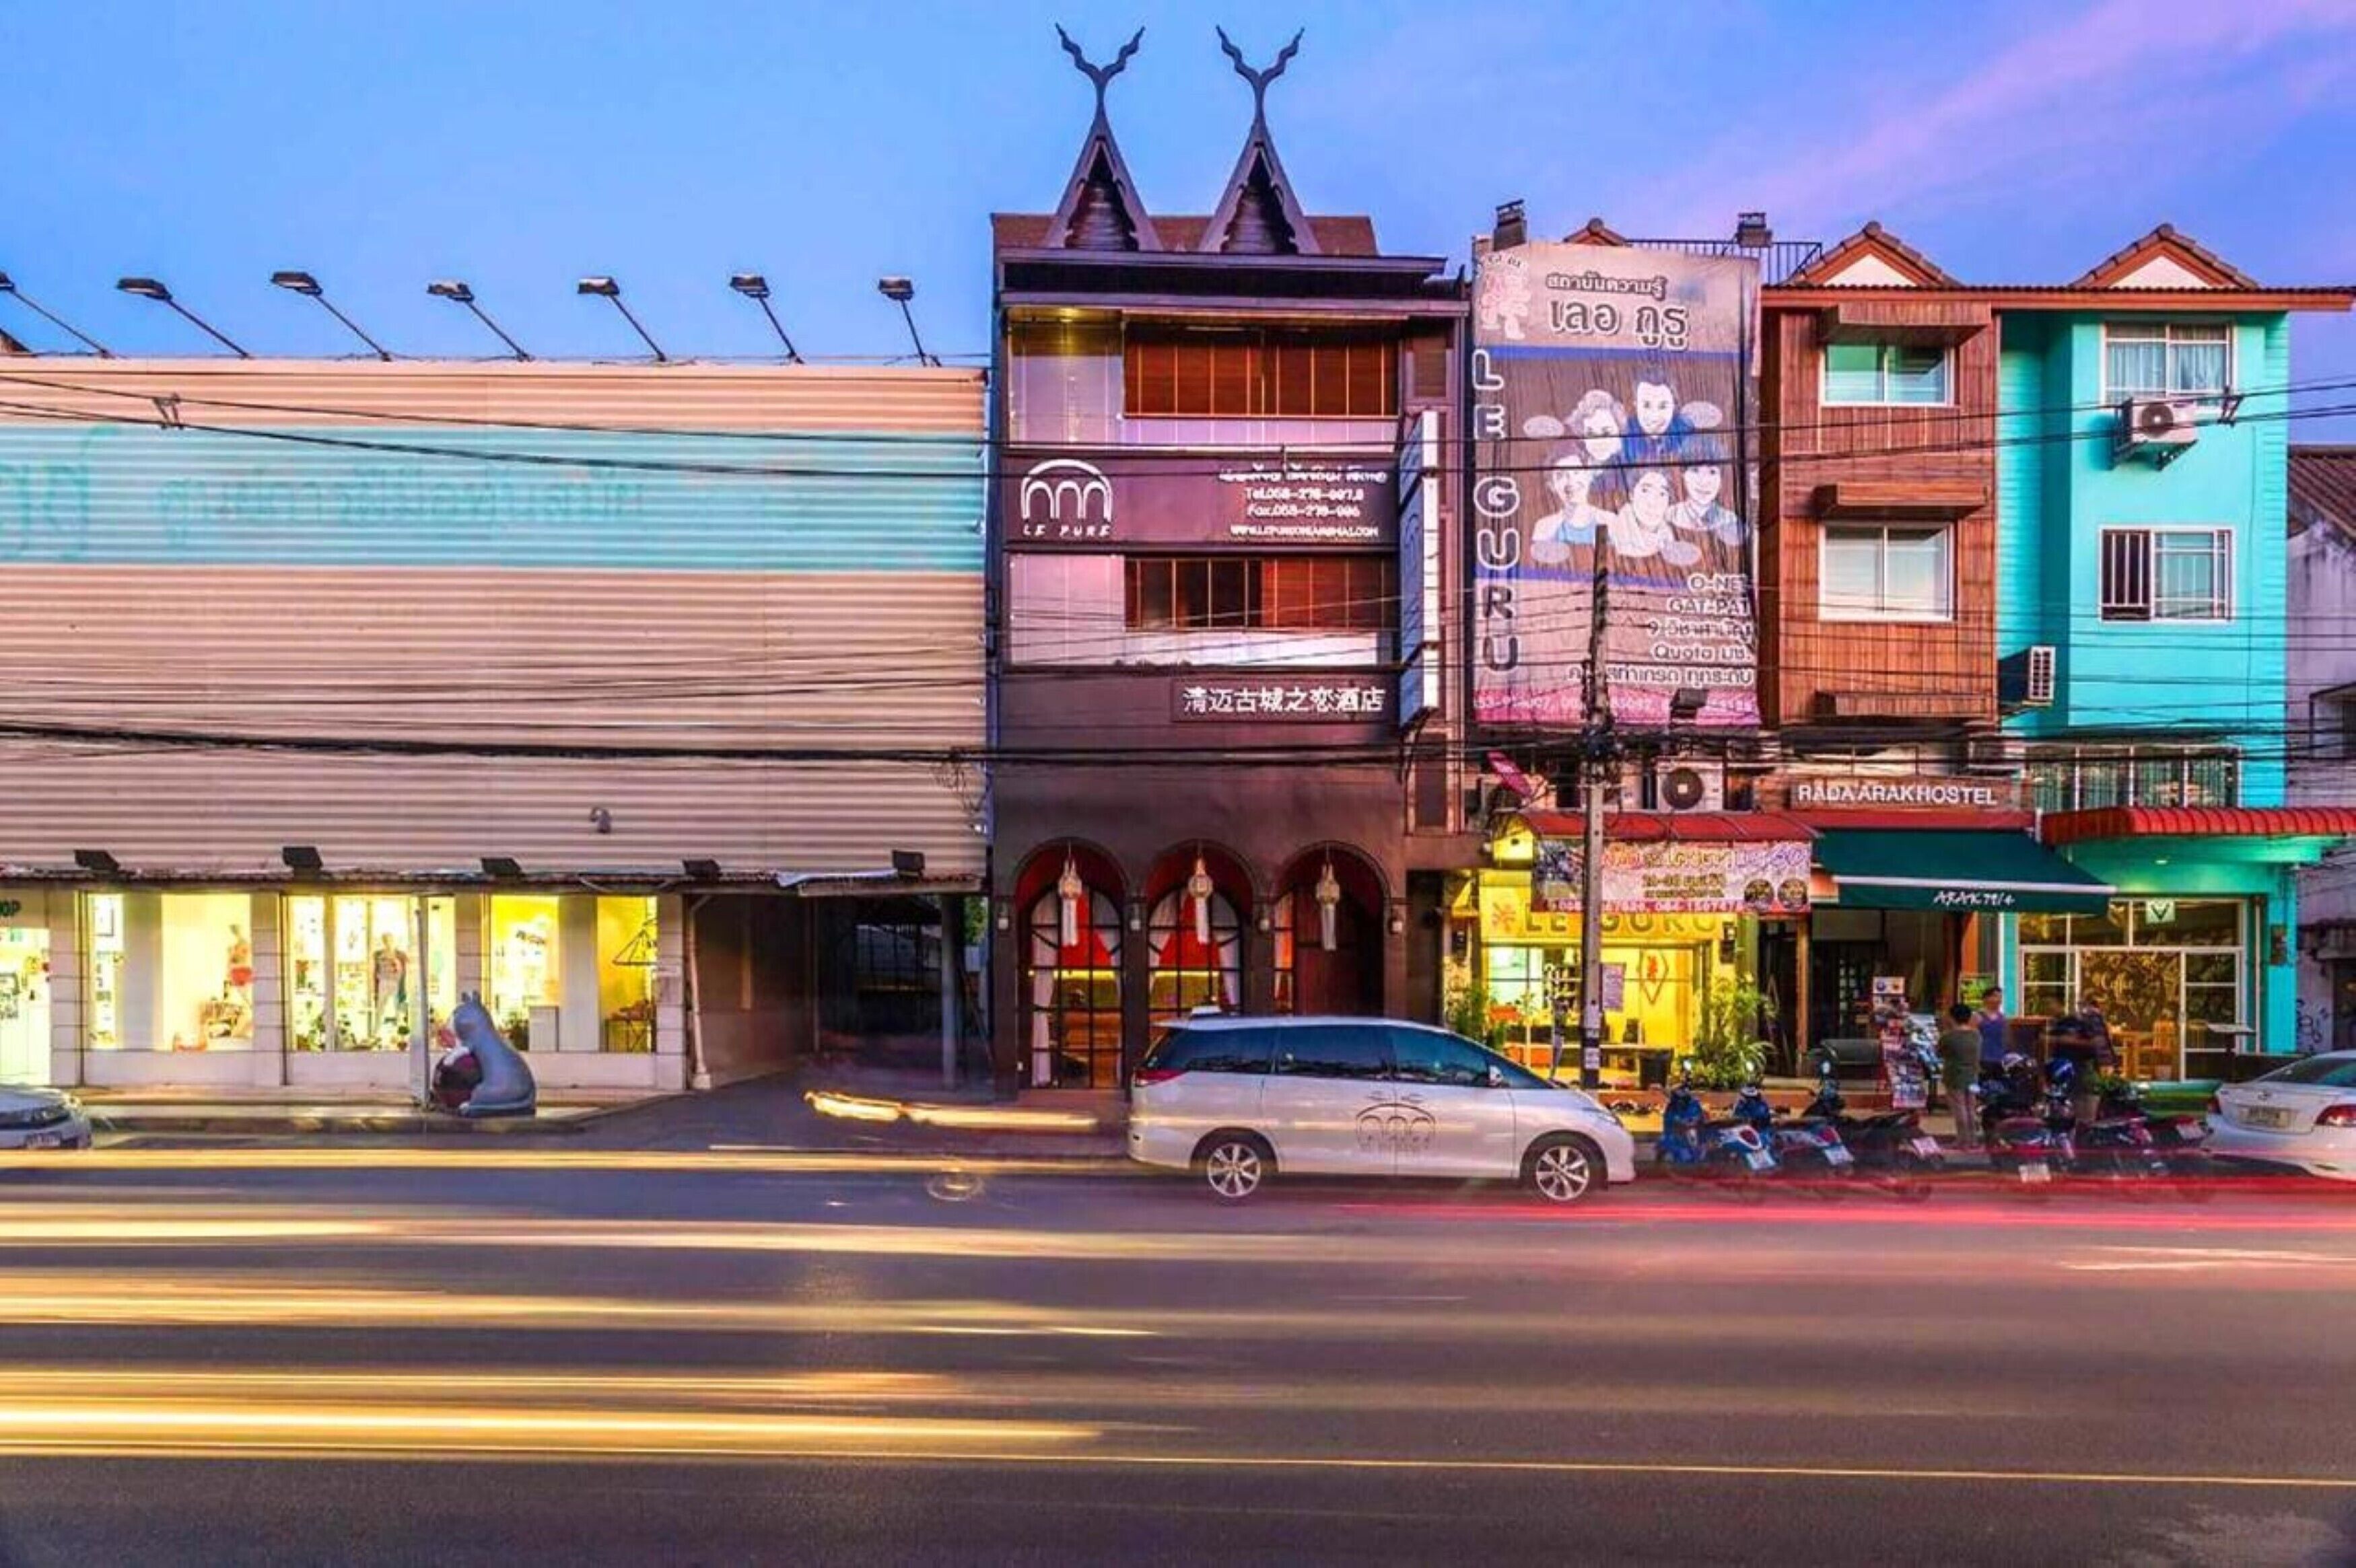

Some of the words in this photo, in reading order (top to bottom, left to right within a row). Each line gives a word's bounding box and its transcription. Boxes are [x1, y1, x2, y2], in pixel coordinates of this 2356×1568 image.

[1546, 271, 1668, 301] สถาบันความรู้
[1550, 299, 1619, 334] เลอ
[1635, 305, 1688, 349] กูรู
[1471, 349, 1505, 441] LE
[1023, 524, 1046, 536] LE
[1059, 524, 1111, 538] PURE
[1474, 476, 1521, 673] GURU
[1798, 784, 1854, 801] RADA
[1857, 785, 1914, 801] ARAK
[1917, 785, 1999, 805] HOSTEL
